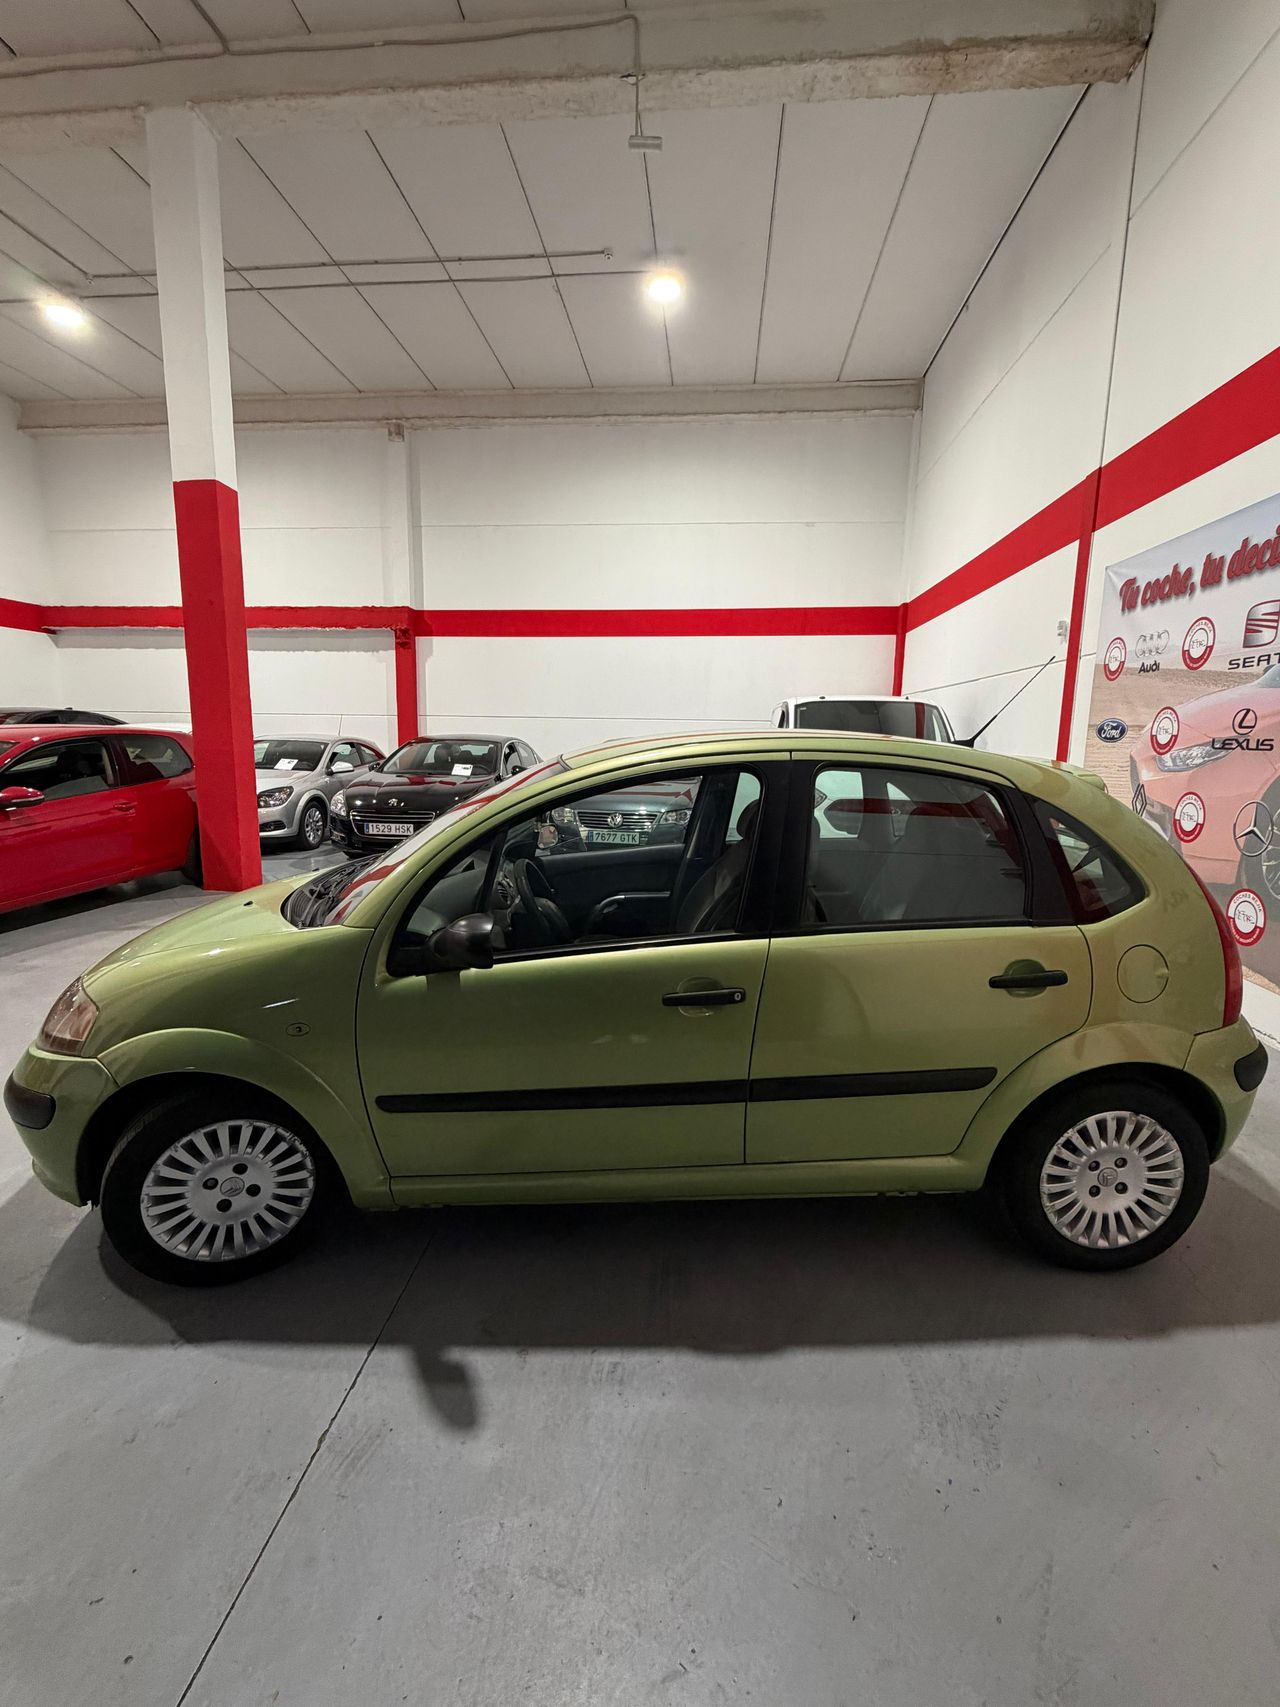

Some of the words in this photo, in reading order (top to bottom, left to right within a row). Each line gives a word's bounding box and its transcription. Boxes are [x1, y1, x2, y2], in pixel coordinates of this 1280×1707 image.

[1119, 577, 1140, 614] Tu
[1141, 563, 1195, 606] coche,
[1200, 552, 1225, 588] tu
[1138, 660, 1160, 673] Audi
[1101, 721, 1122, 738] Ford
[1212, 738, 1274, 751] LEXUS
[370, 824, 392, 833] 1529
[394, 824, 412, 834] HSK
[595, 832, 618, 842] 7677
[620, 833, 638, 843] GTK
